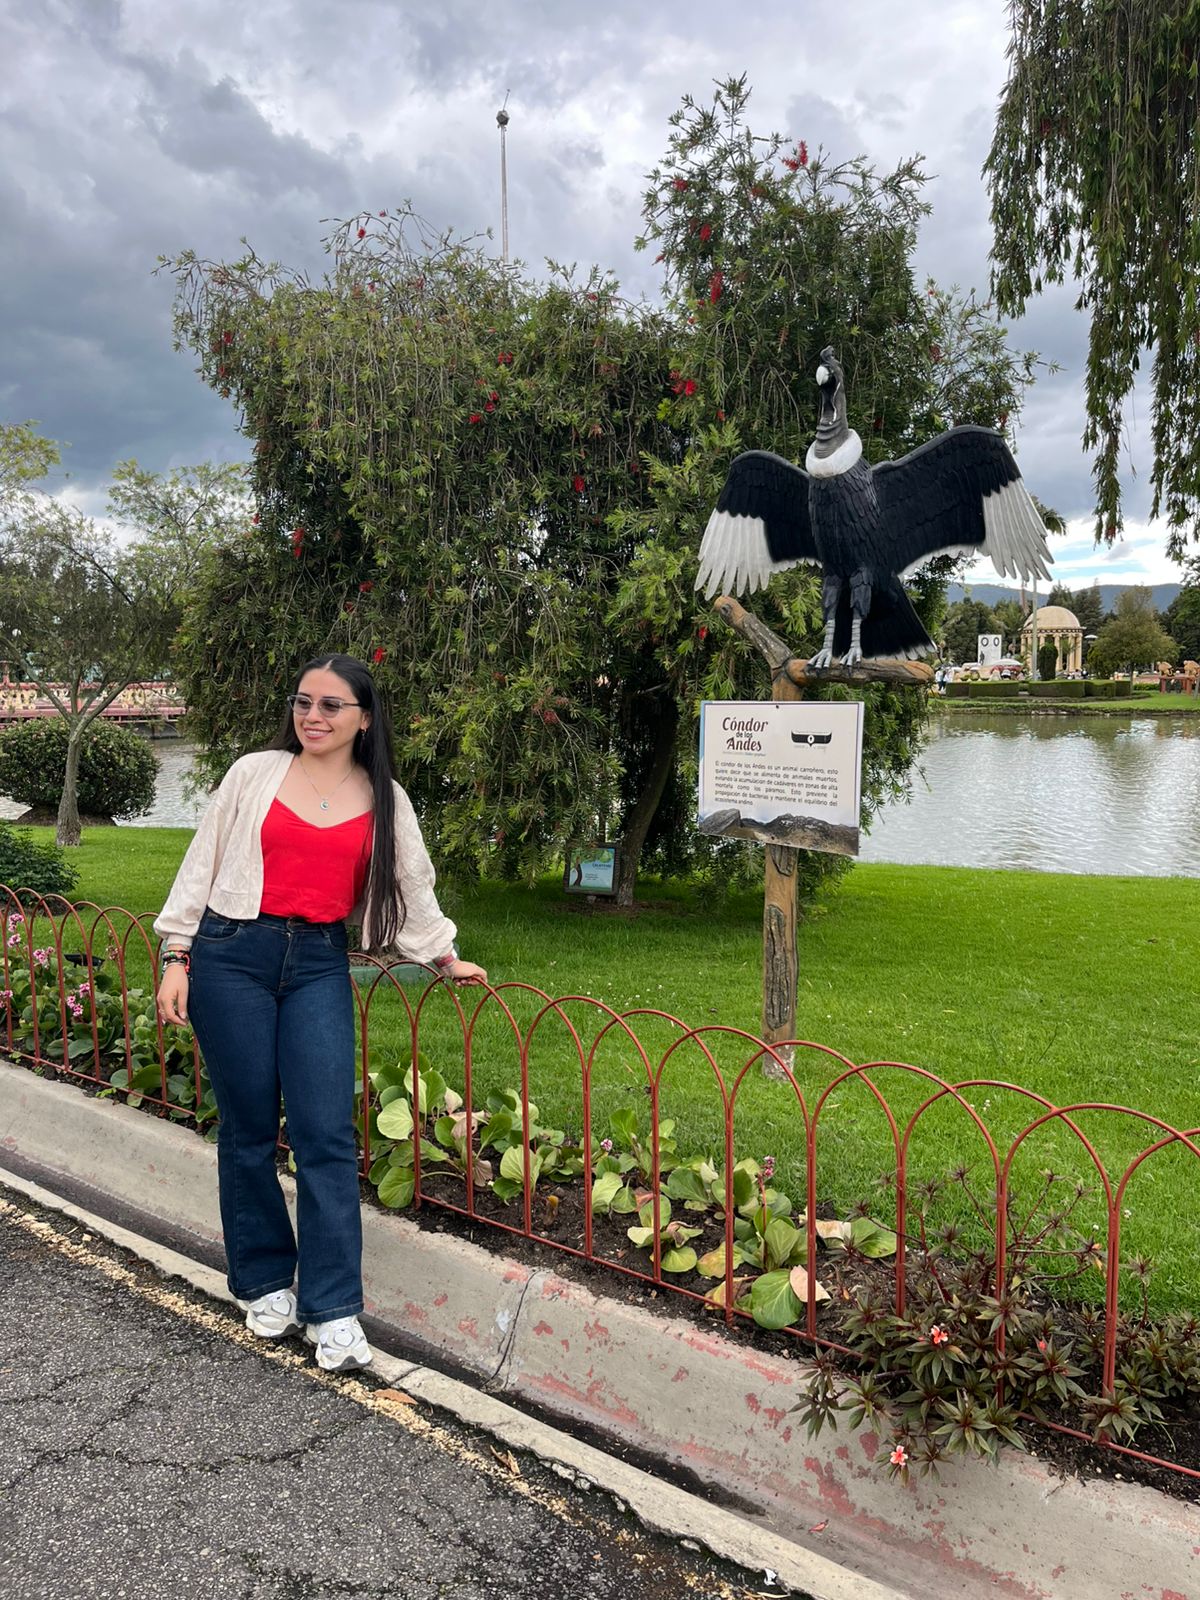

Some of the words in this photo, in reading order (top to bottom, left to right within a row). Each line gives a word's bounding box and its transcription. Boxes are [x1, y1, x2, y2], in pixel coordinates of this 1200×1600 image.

[722, 717, 768, 732] Cóndor
[726, 737, 762, 752] Andes
[792, 773, 813, 781] animales
[749, 792, 769, 800] bacterias
[775, 795, 797, 803] mantiene
[804, 798, 828, 806] equilibrio
